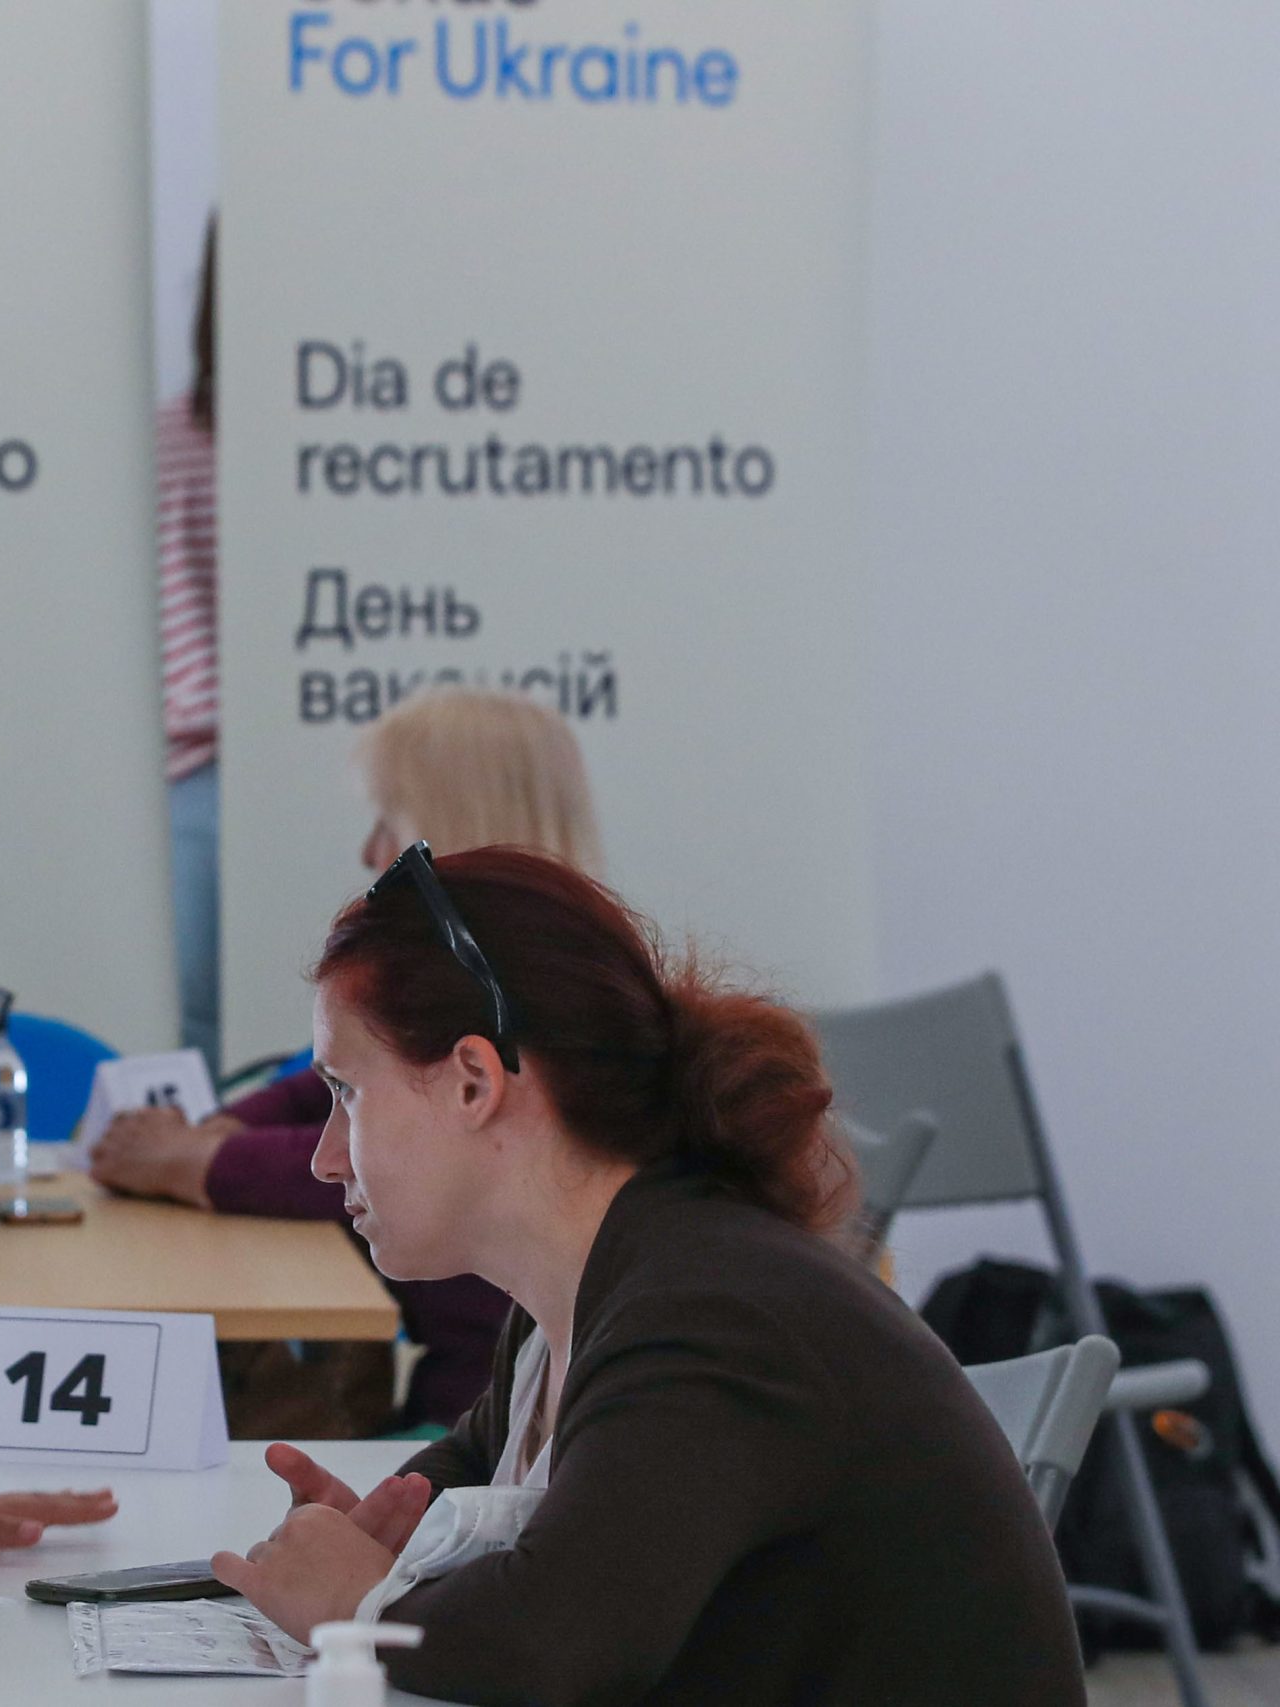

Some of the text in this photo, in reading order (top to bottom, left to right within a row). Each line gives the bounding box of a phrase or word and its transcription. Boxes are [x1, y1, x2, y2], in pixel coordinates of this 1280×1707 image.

[288, 11, 740, 109] For Ukraine
[295, 340, 522, 412] Dia de
[296, 433, 777, 497] recrutamento
[294, 567, 481, 652] День
[4, 1351, 112, 1427] 14
